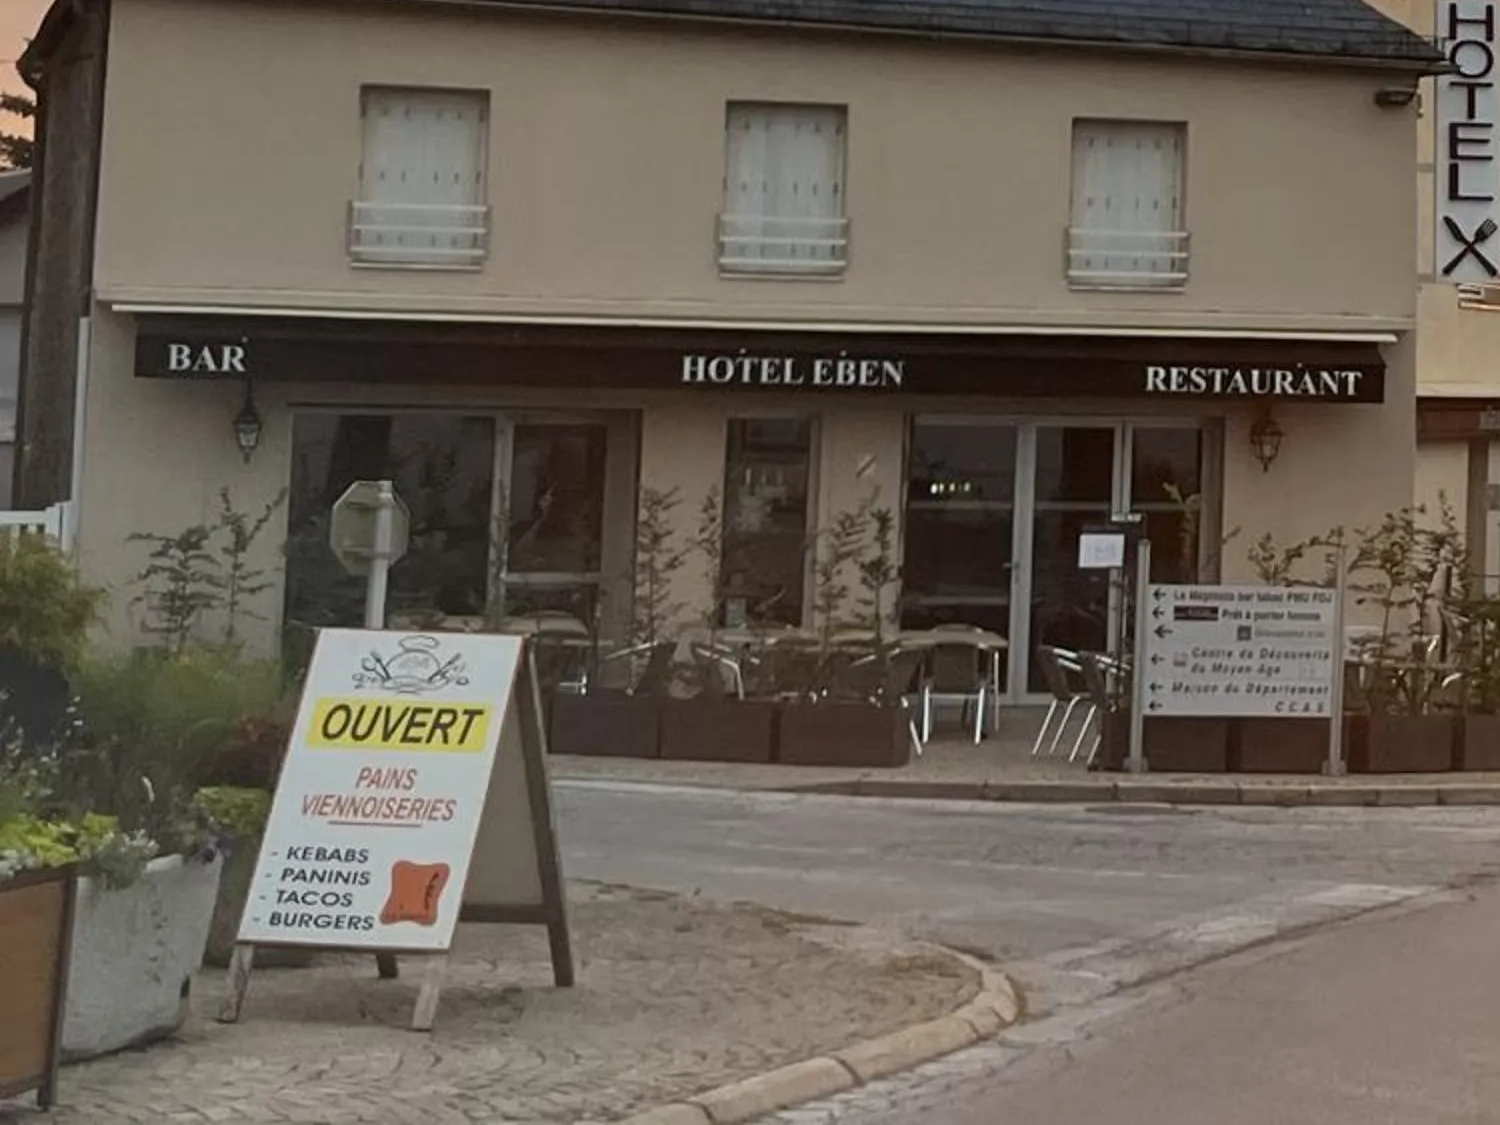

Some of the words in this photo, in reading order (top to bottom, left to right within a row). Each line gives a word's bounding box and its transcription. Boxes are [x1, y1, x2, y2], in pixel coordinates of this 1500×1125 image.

[1449, 3, 1494, 202] HOTEL
[168, 344, 246, 372] BAR
[681, 355, 804, 384] HOTEL
[812, 358, 905, 386] EBEN
[1146, 366, 1363, 396] RESTAURANT
[1191, 646, 1233, 659] Centre
[1211, 662, 1251, 676] Moyen
[322, 704, 484, 745] OUVERT
[356, 766, 418, 791] PAINS
[302, 794, 458, 822] VIENNOISERIES
[286, 846, 370, 864] KEBABS
[280, 867, 371, 885] PANINIS
[276, 888, 353, 907] TACOS
[269, 911, 374, 930] BURGERS
